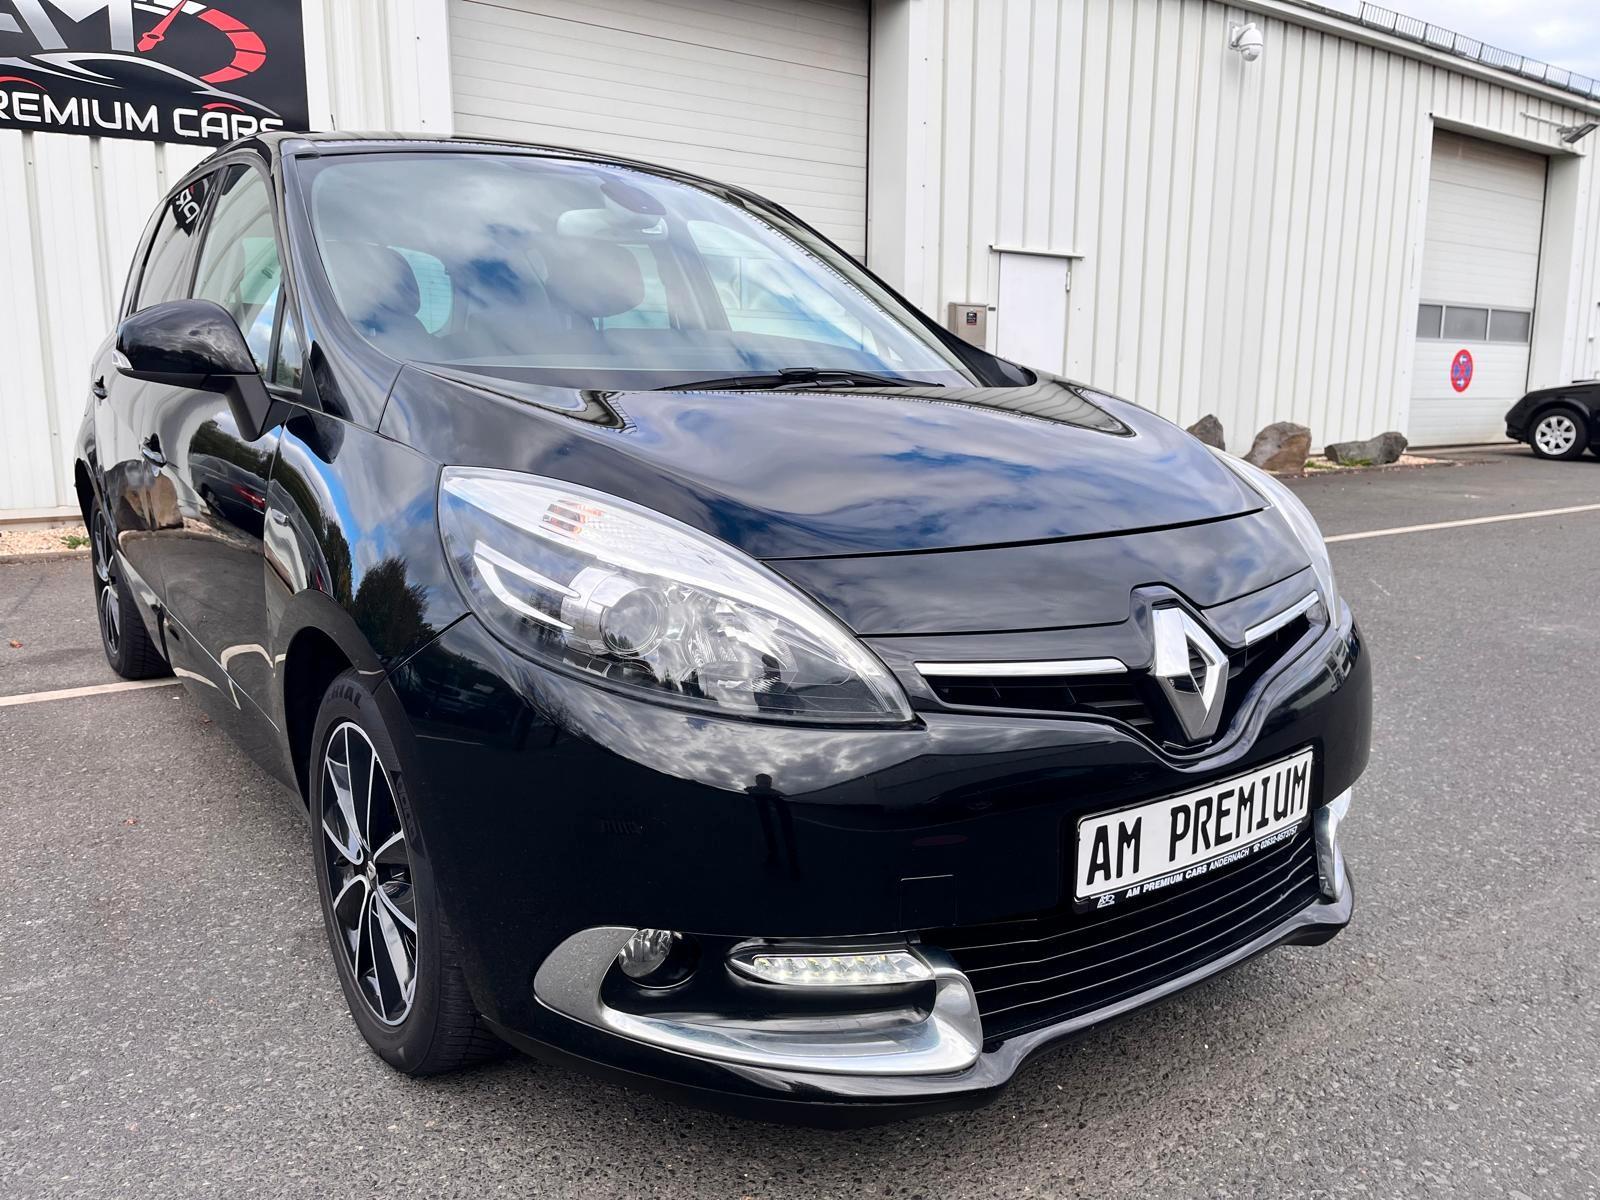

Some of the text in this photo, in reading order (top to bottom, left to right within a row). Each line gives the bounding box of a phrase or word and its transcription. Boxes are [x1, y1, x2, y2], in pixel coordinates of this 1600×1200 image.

[1086, 760, 1307, 885] AM PREMIUM
[1125, 886, 1141, 898] AM
[1142, 873, 1184, 893] PREMIUM
[1185, 864, 1207, 879] CARS
[1209, 848, 1249, 871] ANDERNACH
